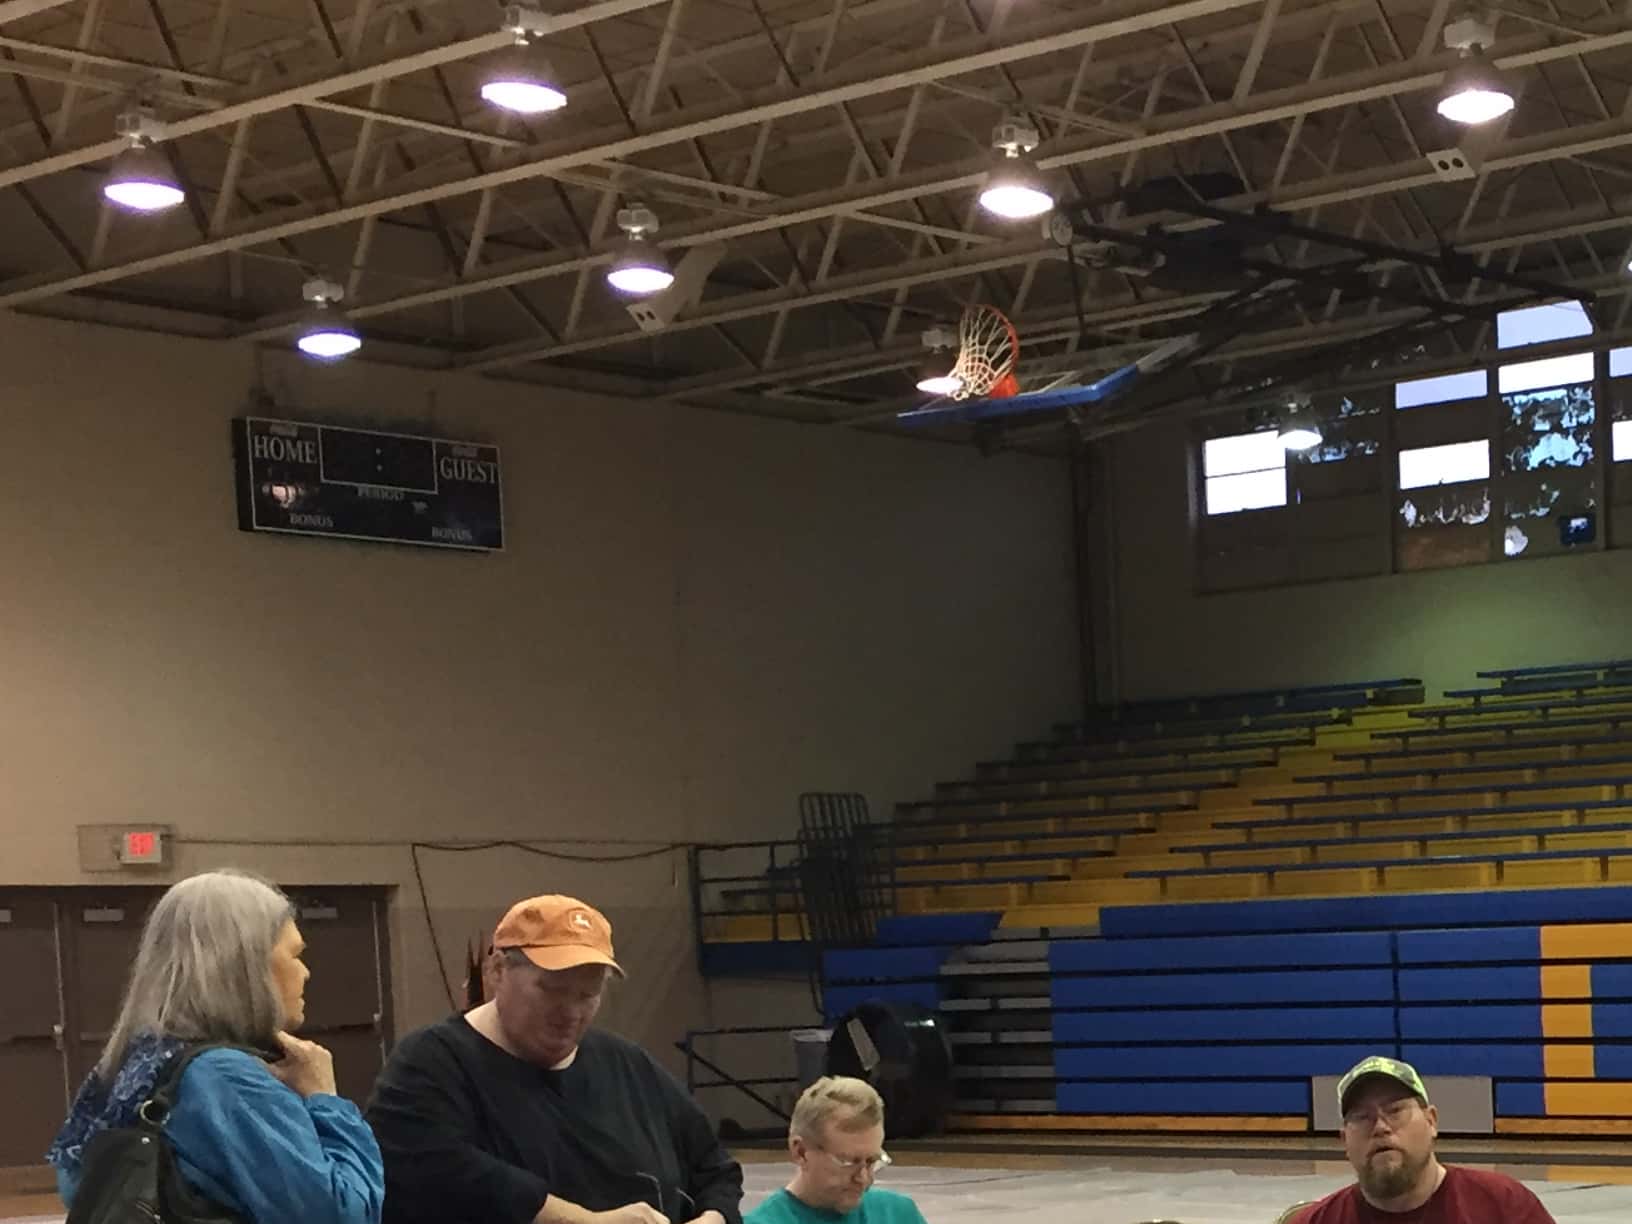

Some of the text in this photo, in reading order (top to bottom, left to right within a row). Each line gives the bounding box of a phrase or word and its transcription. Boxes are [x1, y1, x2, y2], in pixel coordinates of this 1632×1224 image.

[253, 434, 318, 464] HOME
[440, 456, 497, 484] GUEST
[289, 513, 334, 529] BONUS
[432, 526, 473, 542] BONUS
